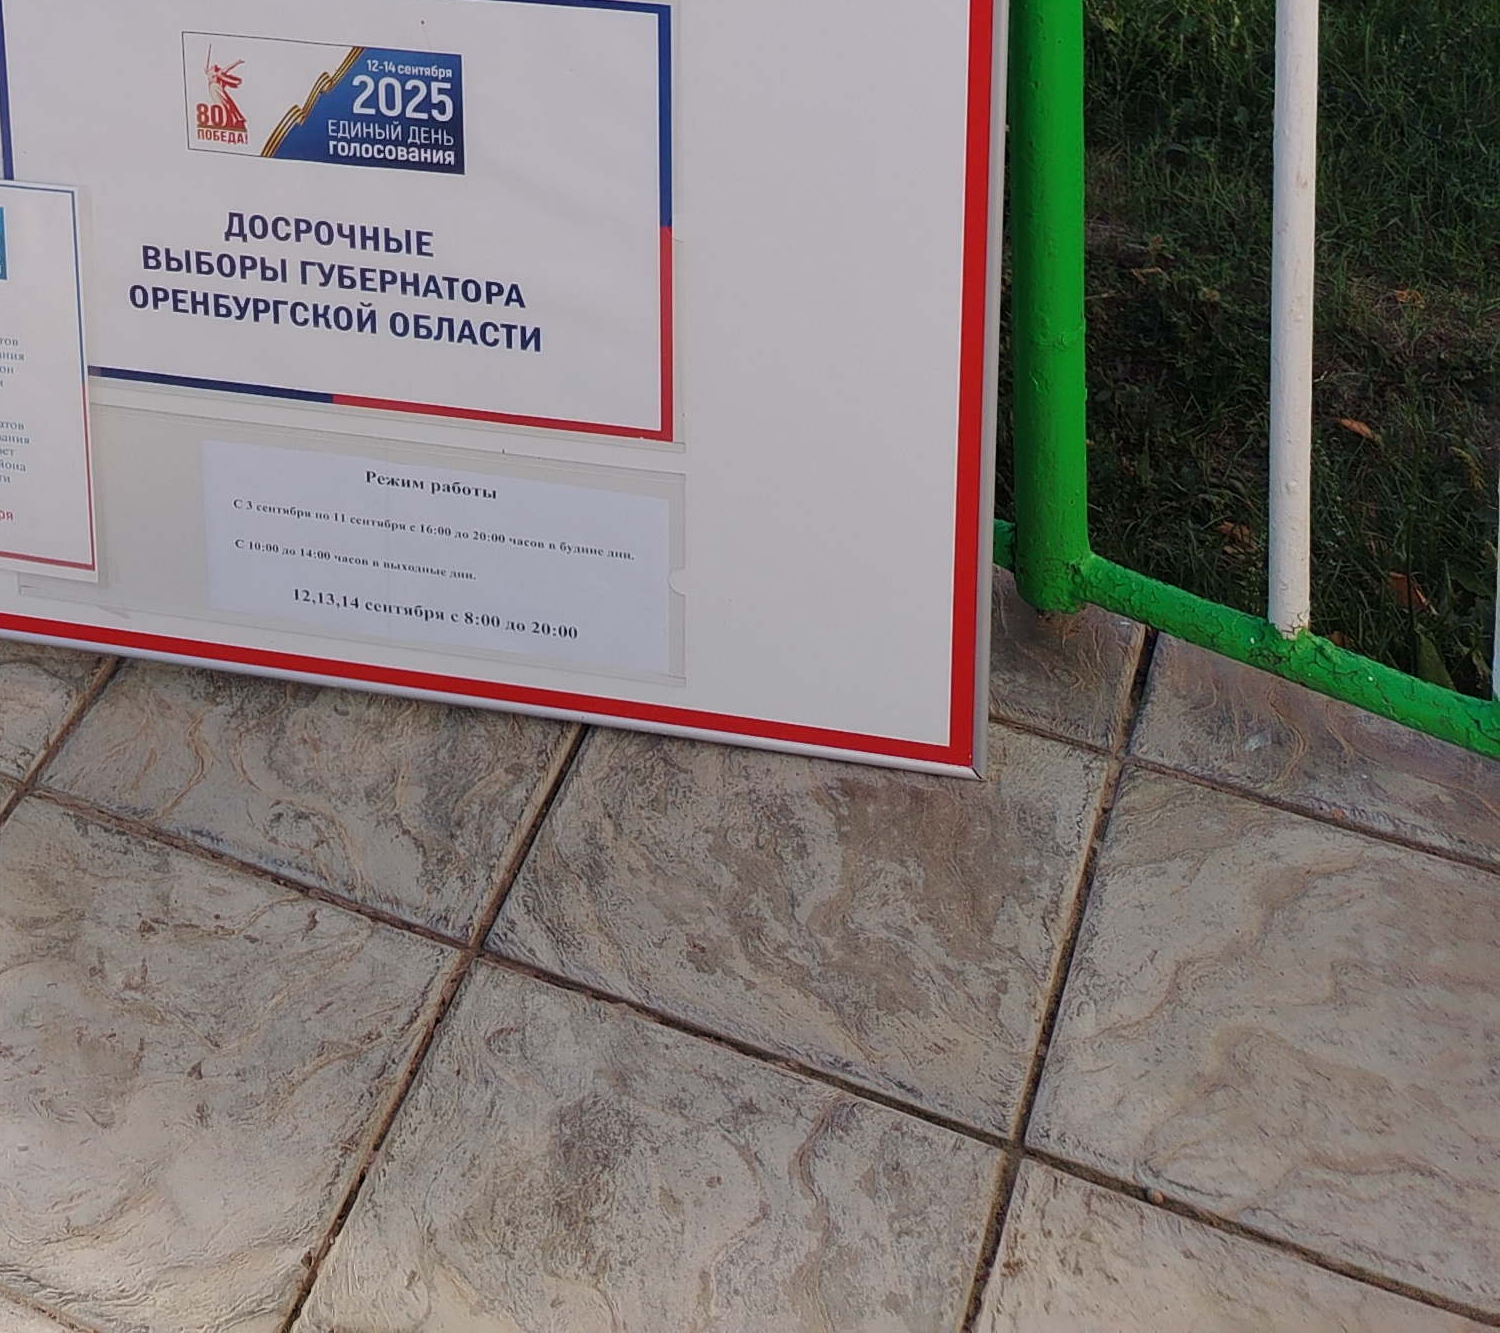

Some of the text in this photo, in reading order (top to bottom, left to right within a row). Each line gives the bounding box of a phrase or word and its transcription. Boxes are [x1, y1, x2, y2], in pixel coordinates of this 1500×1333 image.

[366, 60, 453, 79] 12-14 сентября
[196, 103, 224, 125] 80
[352, 75, 453, 121] 2025
[197, 128, 248, 144] ПОБЕДА!
[328, 119, 454, 146] ЕДИНЫЙ ДЕНЬ
[328, 139, 455, 165] голосования
[224, 211, 434, 258] ДОСРОЧНЫЕ
[142, 244, 526, 308] ВЫБОРЫ ГУБЕРНАТОРА
[129, 284, 542, 352] ОРЕНБУРГСКОЙ ОБЛАСТИ
[365, 470, 497, 499] Режим работы
[233, 499, 243, 509] С
[246, 501, 252, 510] 3
[256, 505, 311, 519] сентября
[315, 512, 329, 520] по
[334, 512, 345, 522] 11
[350, 516, 406, 531] сентября
[421, 524, 451, 536] 16:00
[455, 530, 469, 539] до
[473, 531, 505, 543] 20:00
[509, 538, 544, 549] часов
[560, 542, 604, 556] будние
[235, 539, 244, 548] С
[249, 541, 279, 553] 10:00
[300, 548, 330, 560] 14:00
[334, 555, 368, 566] часов
[383, 561, 447, 577] выходные
[294, 589, 359, 609] 12,13,14
[365, 601, 444, 621] сентября
[464, 612, 500, 628] 8:00
[505, 620, 525, 632] до
[532, 622, 578, 639] 20:00
